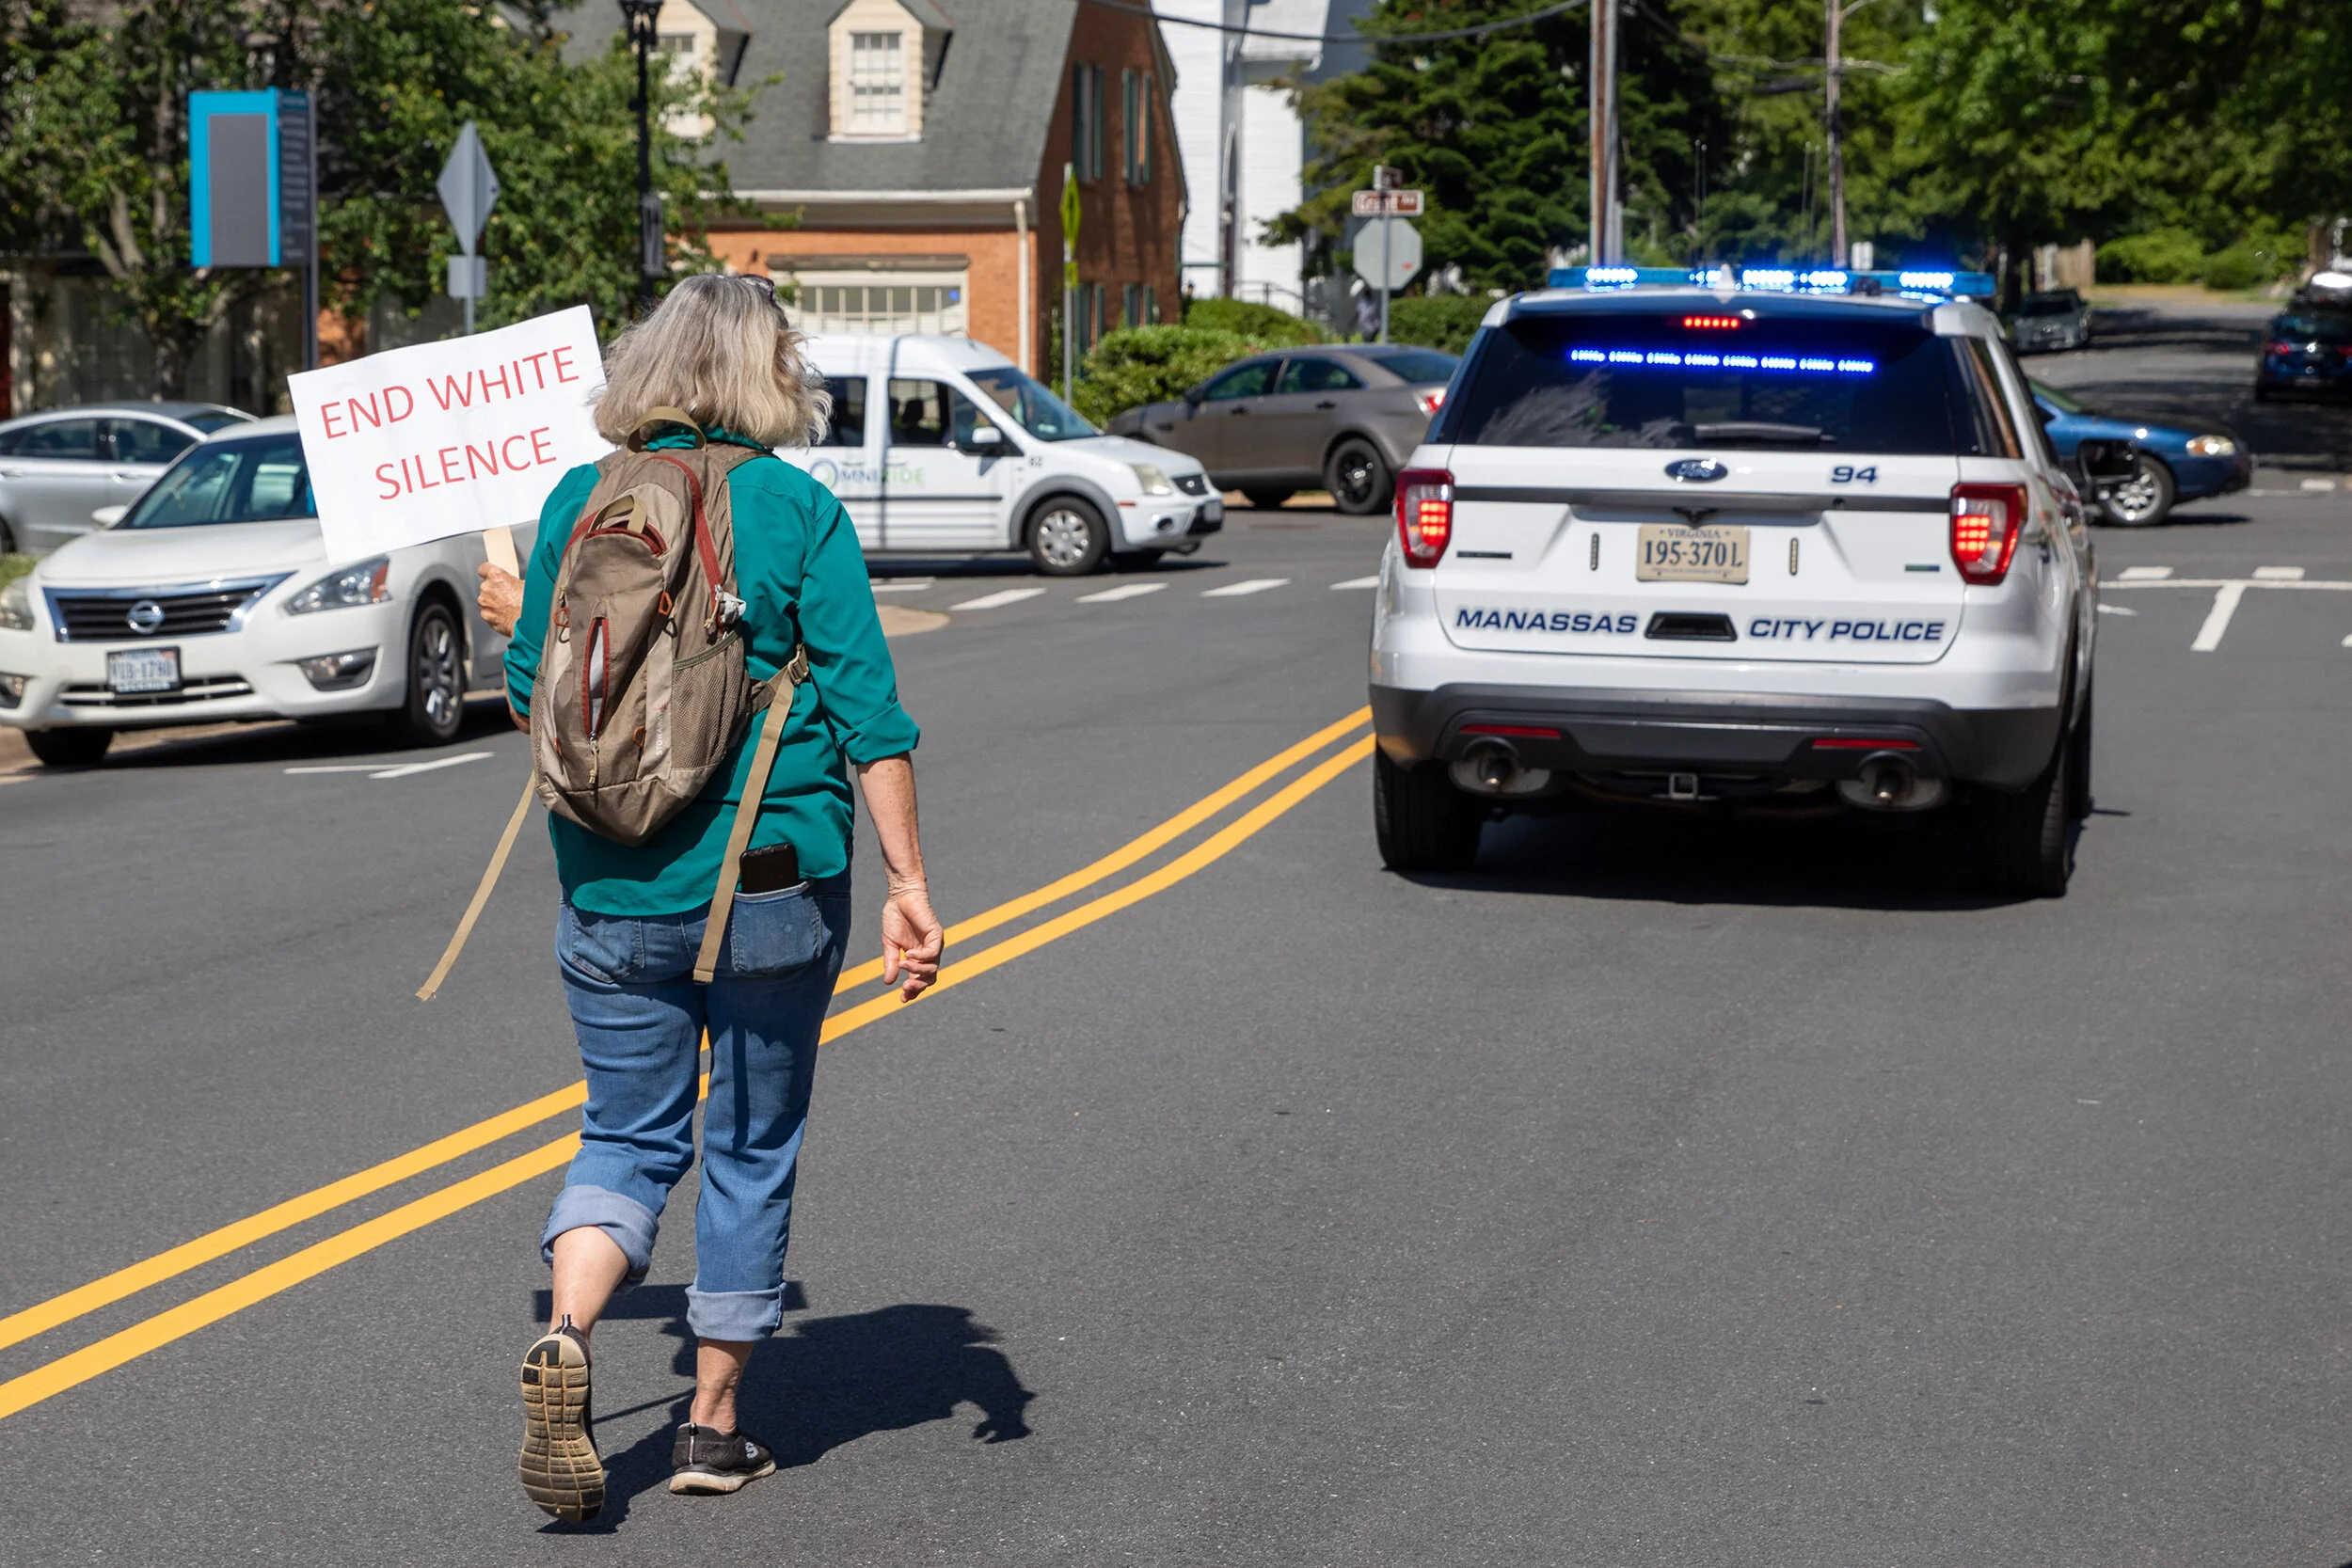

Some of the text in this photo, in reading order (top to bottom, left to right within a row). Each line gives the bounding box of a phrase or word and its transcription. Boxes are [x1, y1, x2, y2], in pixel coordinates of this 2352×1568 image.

[321, 346, 580, 439] END WHITE
[375, 426, 557, 499] SILENCE
[1831, 466, 1878, 483] 94
[1667, 528, 1721, 539] VIRGINIA
[1456, 609, 1638, 634] MANASSAS
[1750, 619, 1945, 641] CITY POLICE
